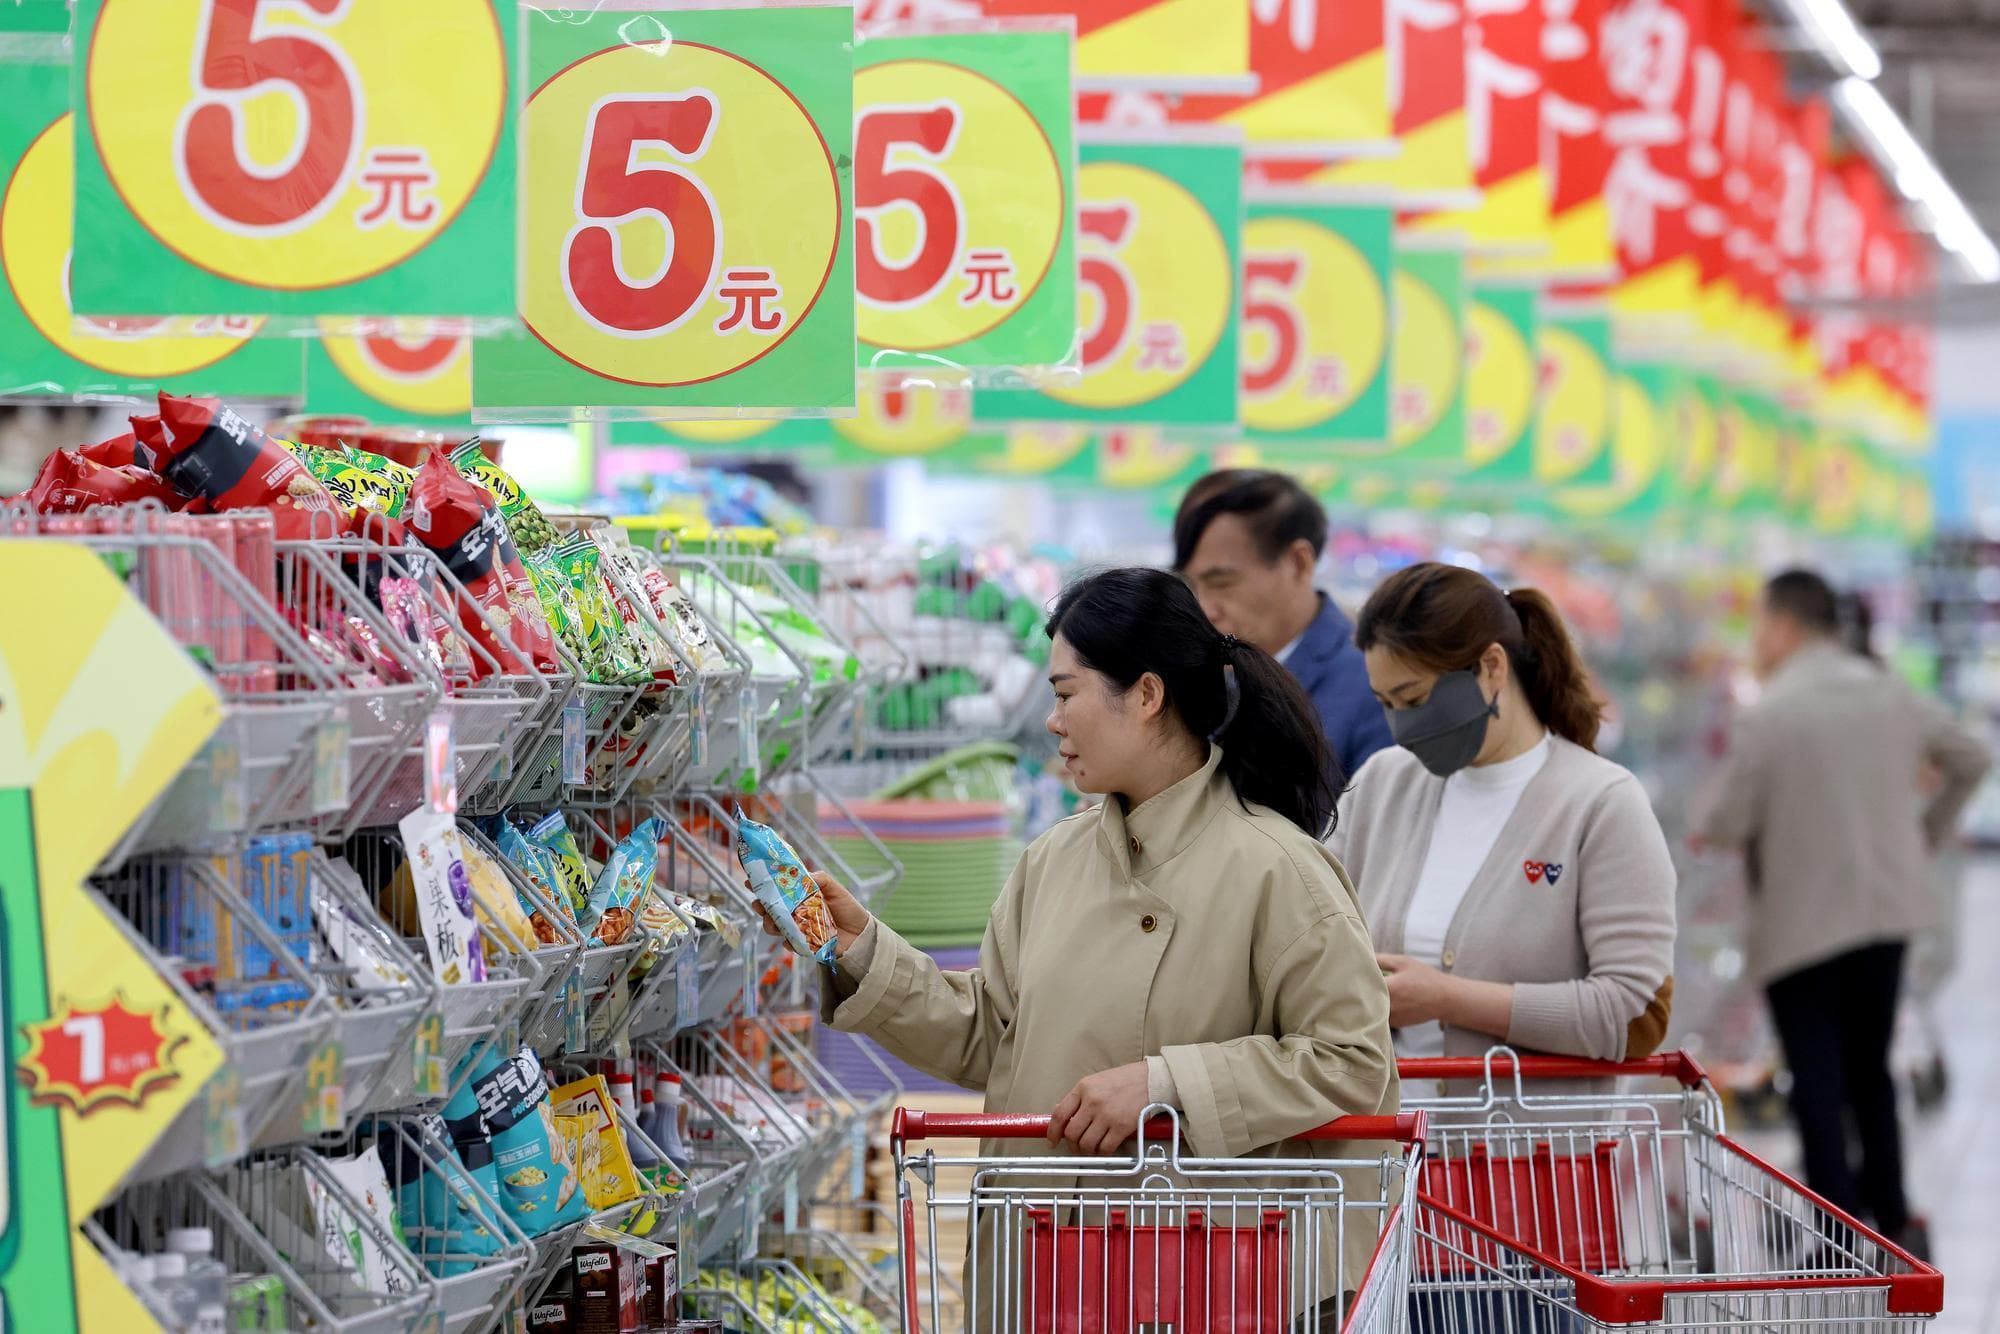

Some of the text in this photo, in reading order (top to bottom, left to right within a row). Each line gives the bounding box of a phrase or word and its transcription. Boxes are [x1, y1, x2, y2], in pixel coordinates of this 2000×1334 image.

[561, 88, 788, 339] 5元
[64, 1016, 105, 1083] 1
[578, 1256, 609, 1270] Wafello
[533, 1309, 564, 1321] Wafello
